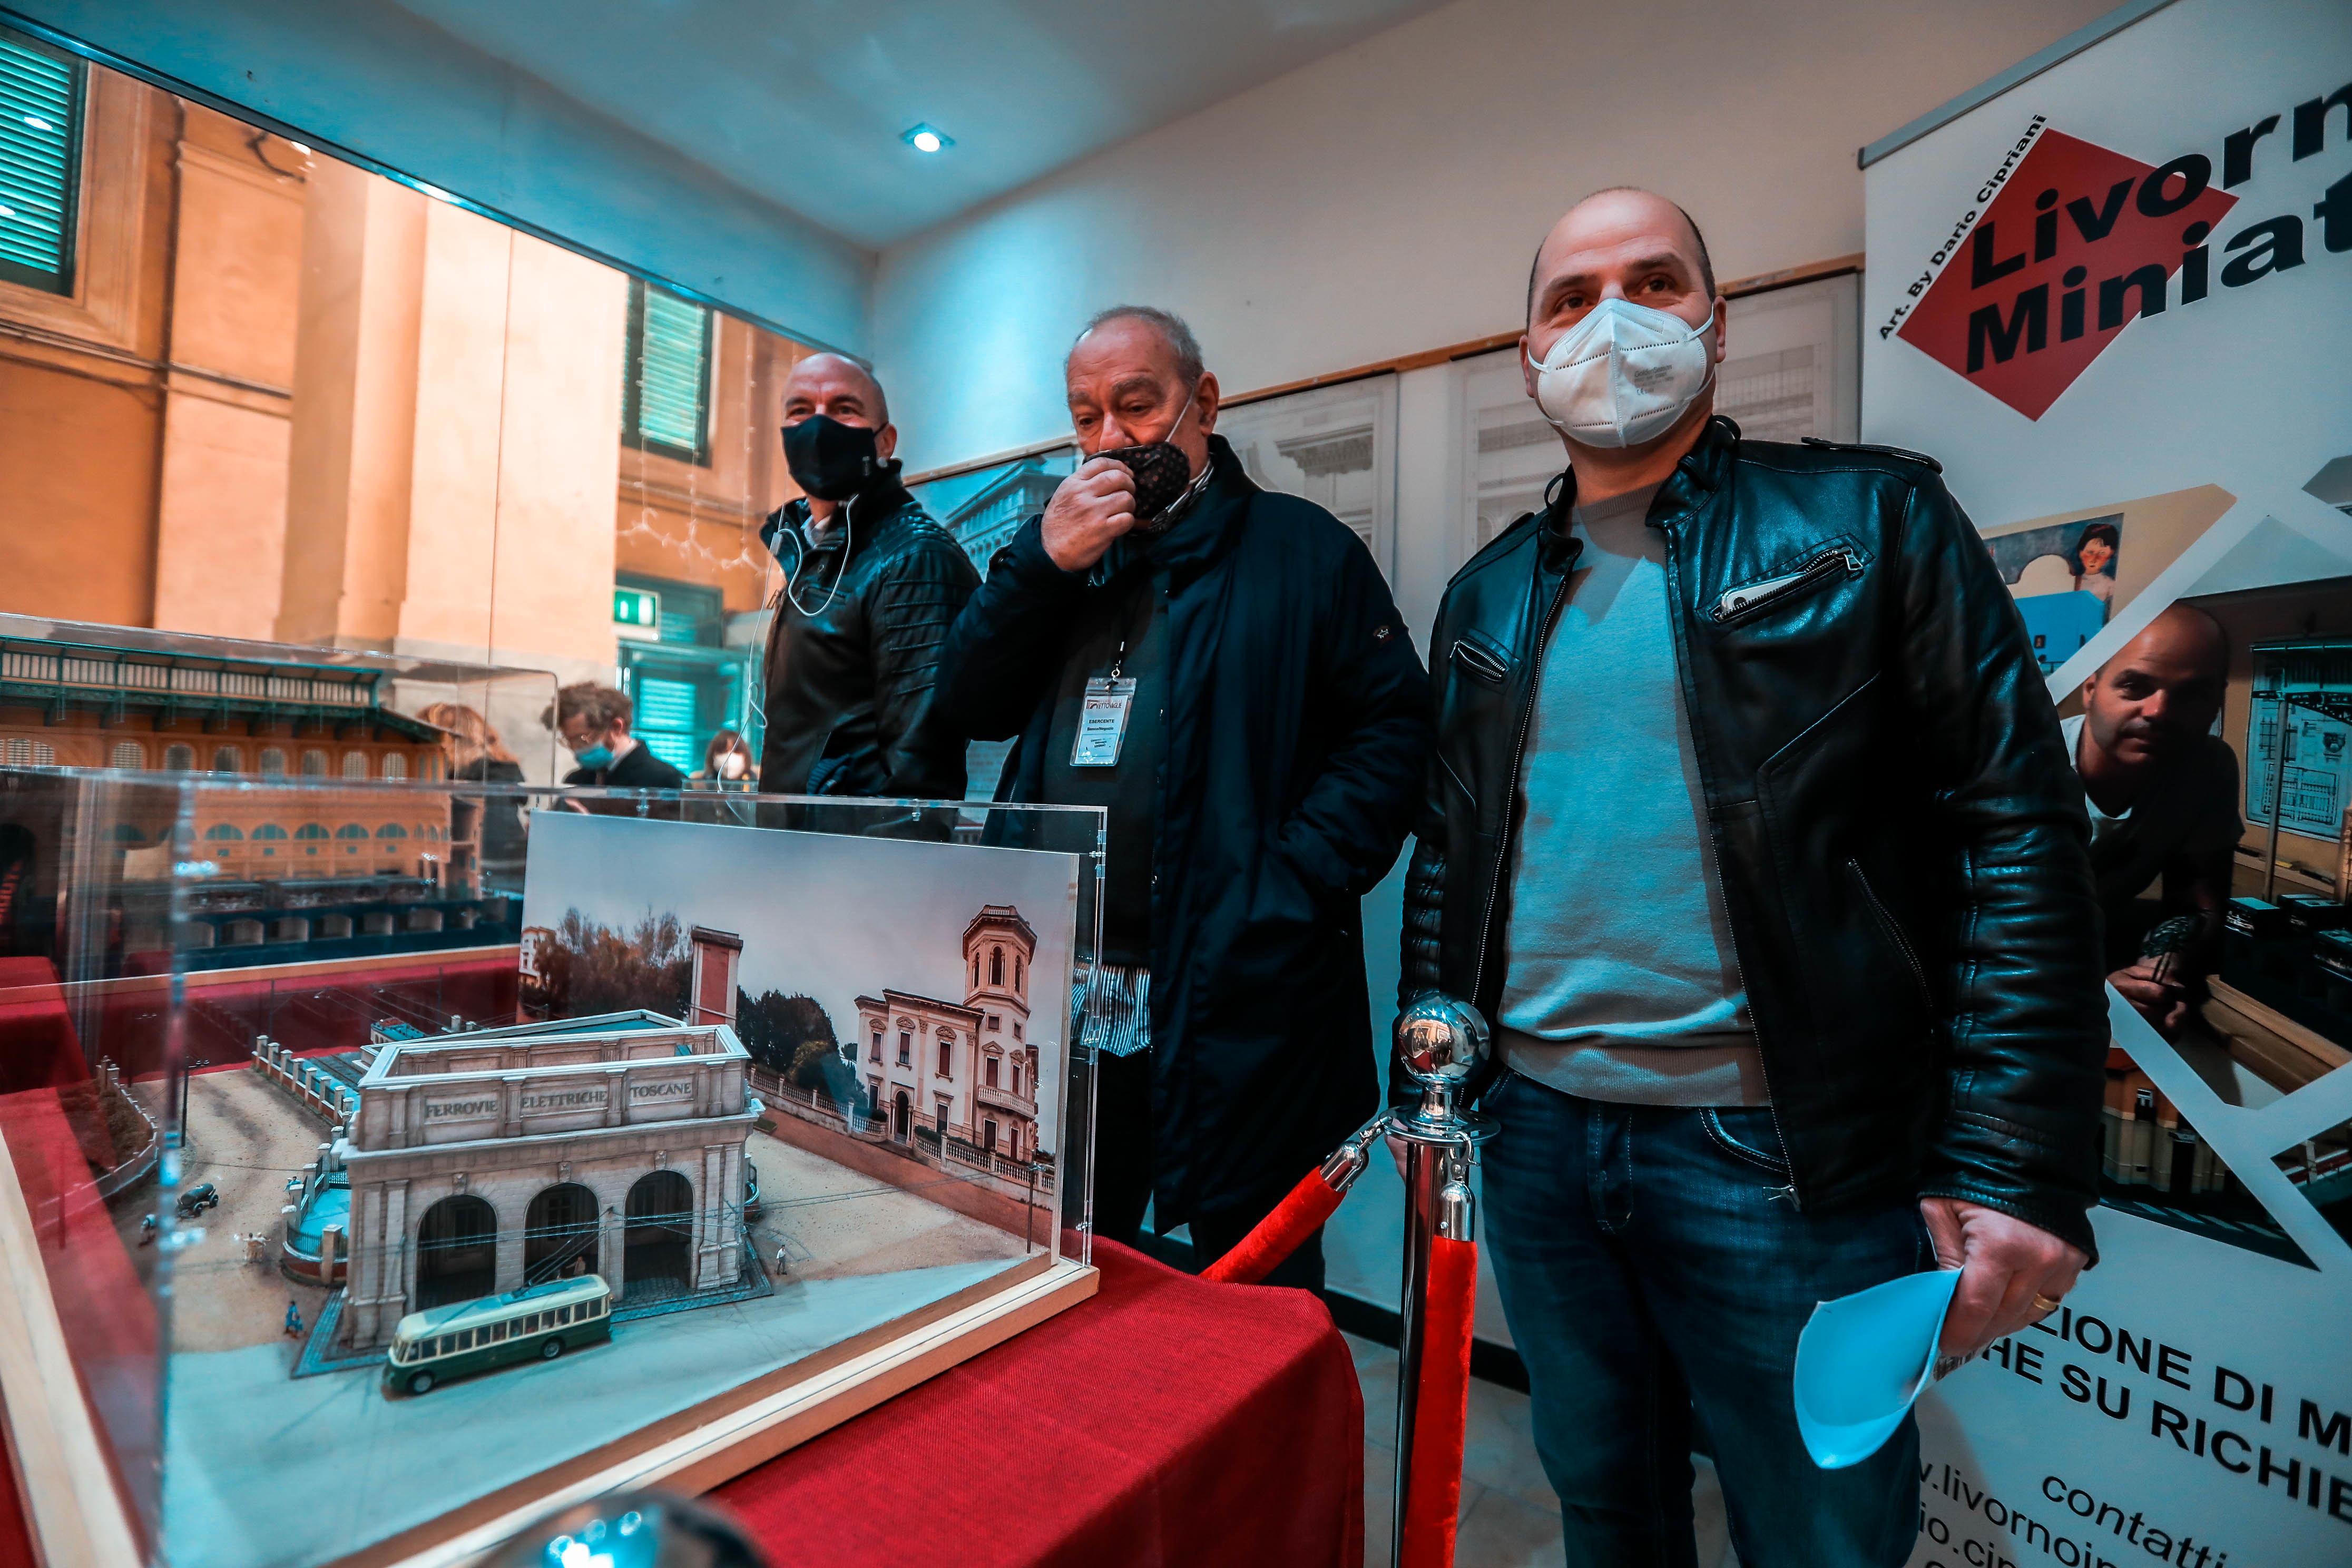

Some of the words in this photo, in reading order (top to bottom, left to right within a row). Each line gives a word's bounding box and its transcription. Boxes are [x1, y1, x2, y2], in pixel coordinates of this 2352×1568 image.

[1971, 81, 2352, 290] Livorn
[1880, 303, 1910, 340] Art.
[1907, 270, 1933, 298] By
[1930, 210, 1977, 266] Dario
[1977, 114, 2047, 203] Cipriani
[425, 1099, 498, 1118] FERROVIE
[522, 1090, 608, 1109] ELETTRICHE
[630, 1082, 692, 1098] TOSCANE
[2060, 1364, 2131, 1420] SU
[2213, 1366, 2273, 1424] DI
